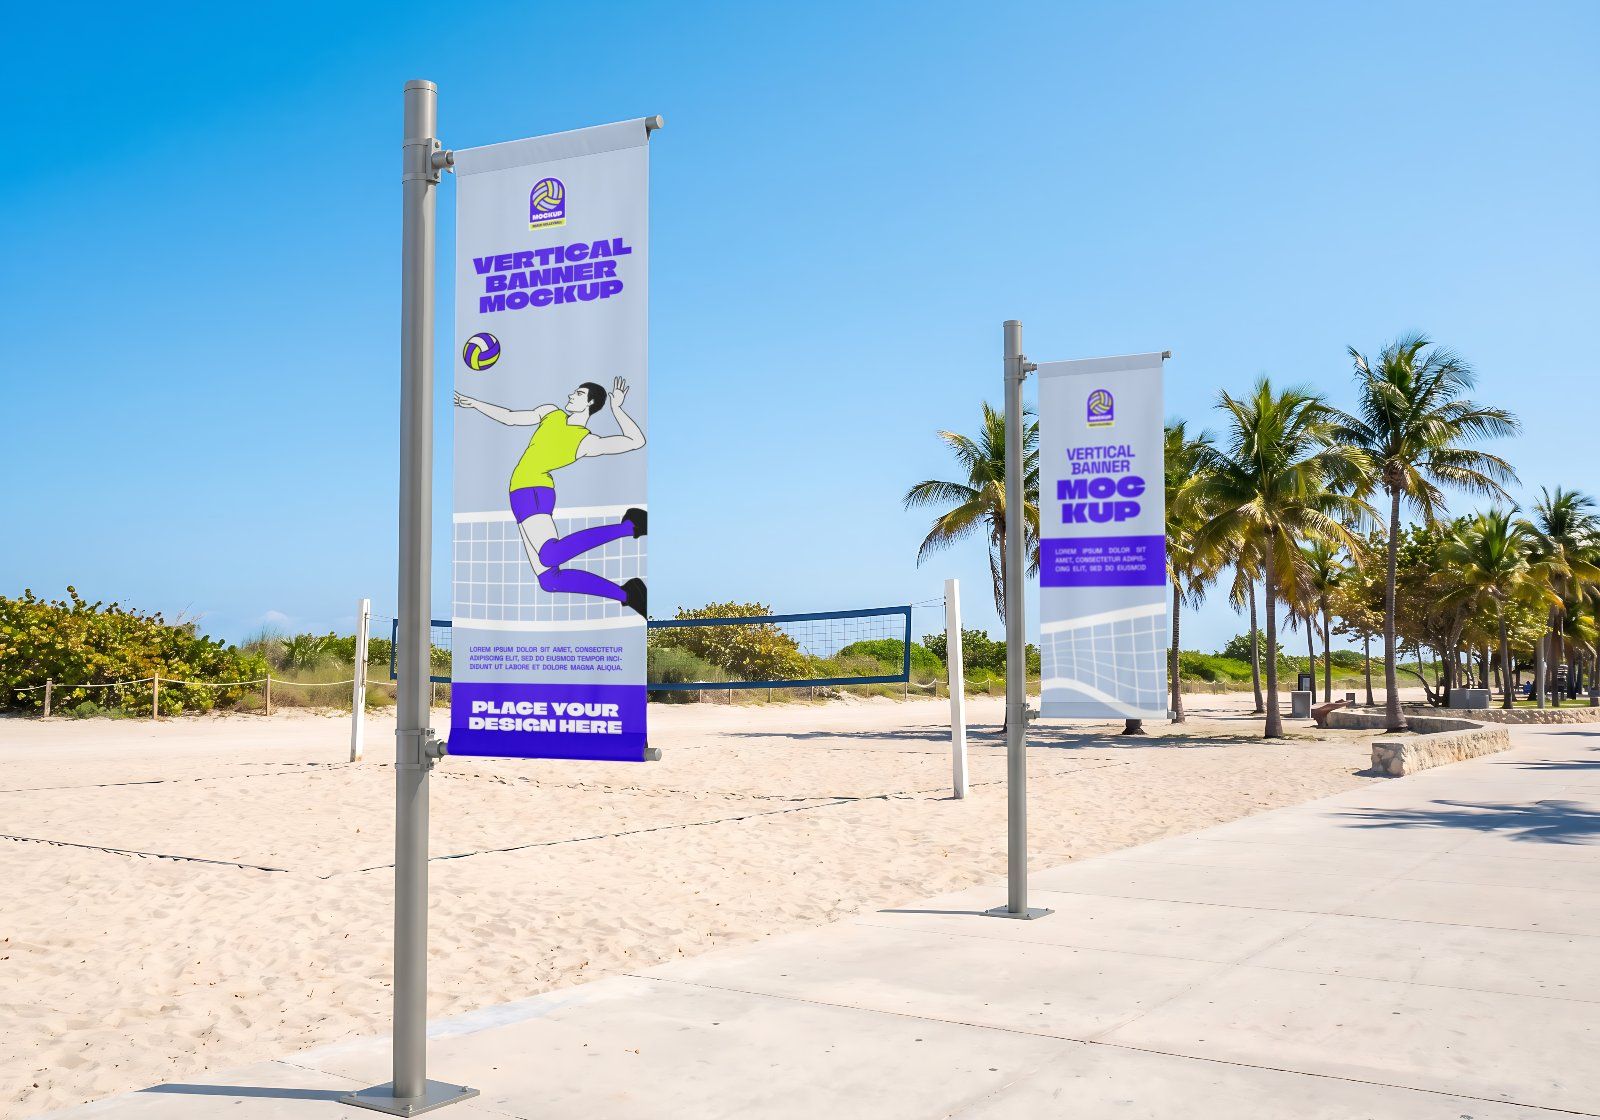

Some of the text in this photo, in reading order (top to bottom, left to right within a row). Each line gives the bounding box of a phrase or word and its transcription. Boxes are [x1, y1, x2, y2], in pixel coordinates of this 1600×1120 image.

[532, 210, 562, 220] MOCKUP
[473, 237, 632, 274] VERTICAL
[486, 260, 617, 293] BANNER
[480, 280, 623, 313] MOCKUP
[1067, 445, 1135, 460] VERTICAL
[1071, 460, 1130, 475] BANNER
[1057, 476, 1145, 500] MOC
[1062, 501, 1140, 524] KUP
[472, 701, 619, 717] PLACE YOUR
[469, 717, 622, 734] DESIGN HERE
